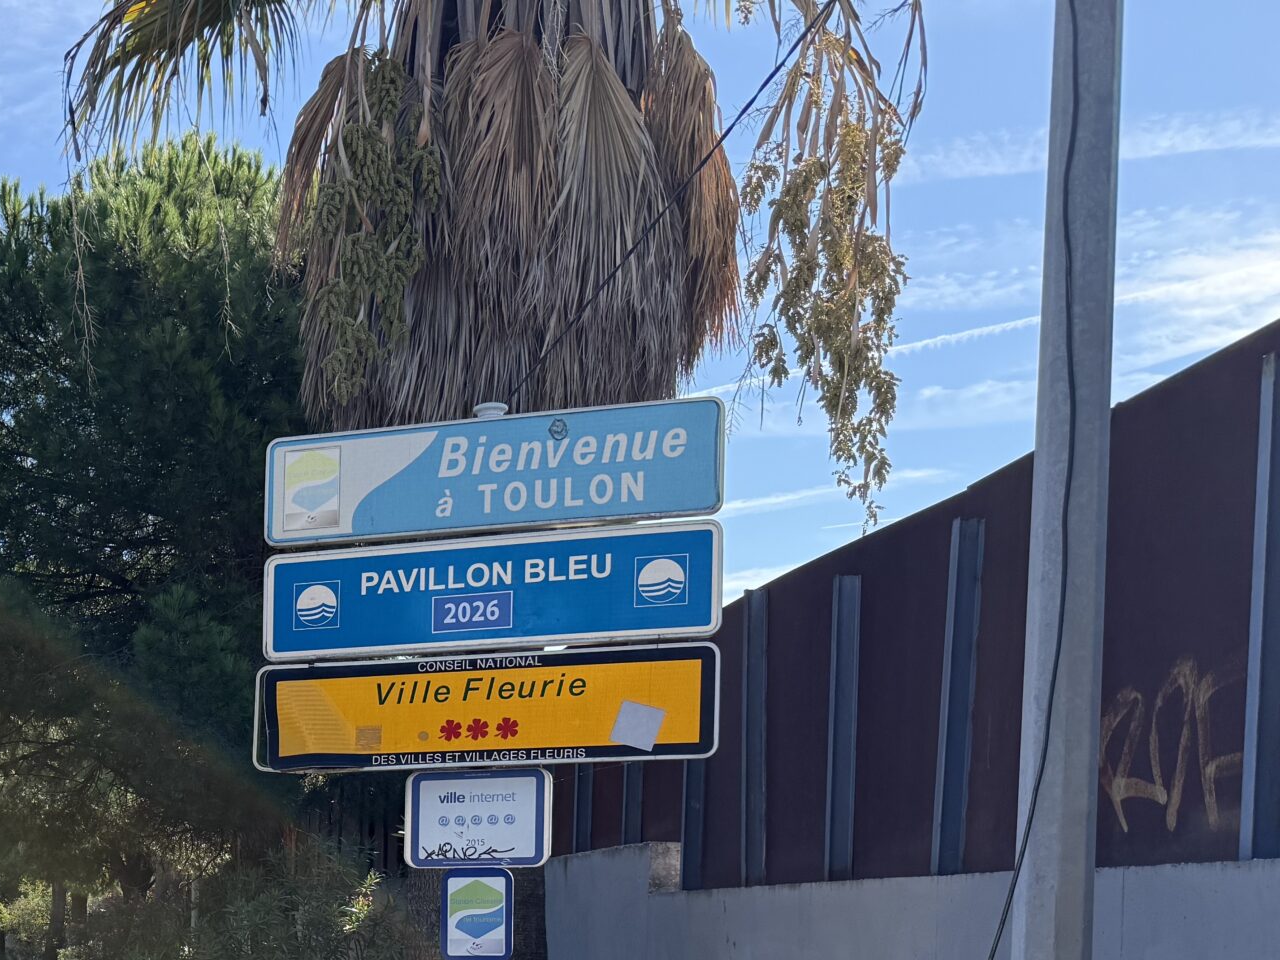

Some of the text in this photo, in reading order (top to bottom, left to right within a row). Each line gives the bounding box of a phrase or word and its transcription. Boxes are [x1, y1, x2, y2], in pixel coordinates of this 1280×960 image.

[438, 427, 688, 478] Bienvenue
[435, 471, 645, 518] à TOULON
[361, 553, 613, 596] PAVILLON BLEU
[443, 600, 500, 624] 2026
[417, 655, 542, 672] CONSEIL NATIONAL
[376, 673, 587, 706] Ville Fleurie
[372, 748, 587, 765] DES VILLES ET VILLAGES FLEURIS
[438, 791, 517, 804] ville internet
[466, 838, 486, 847] 2015
